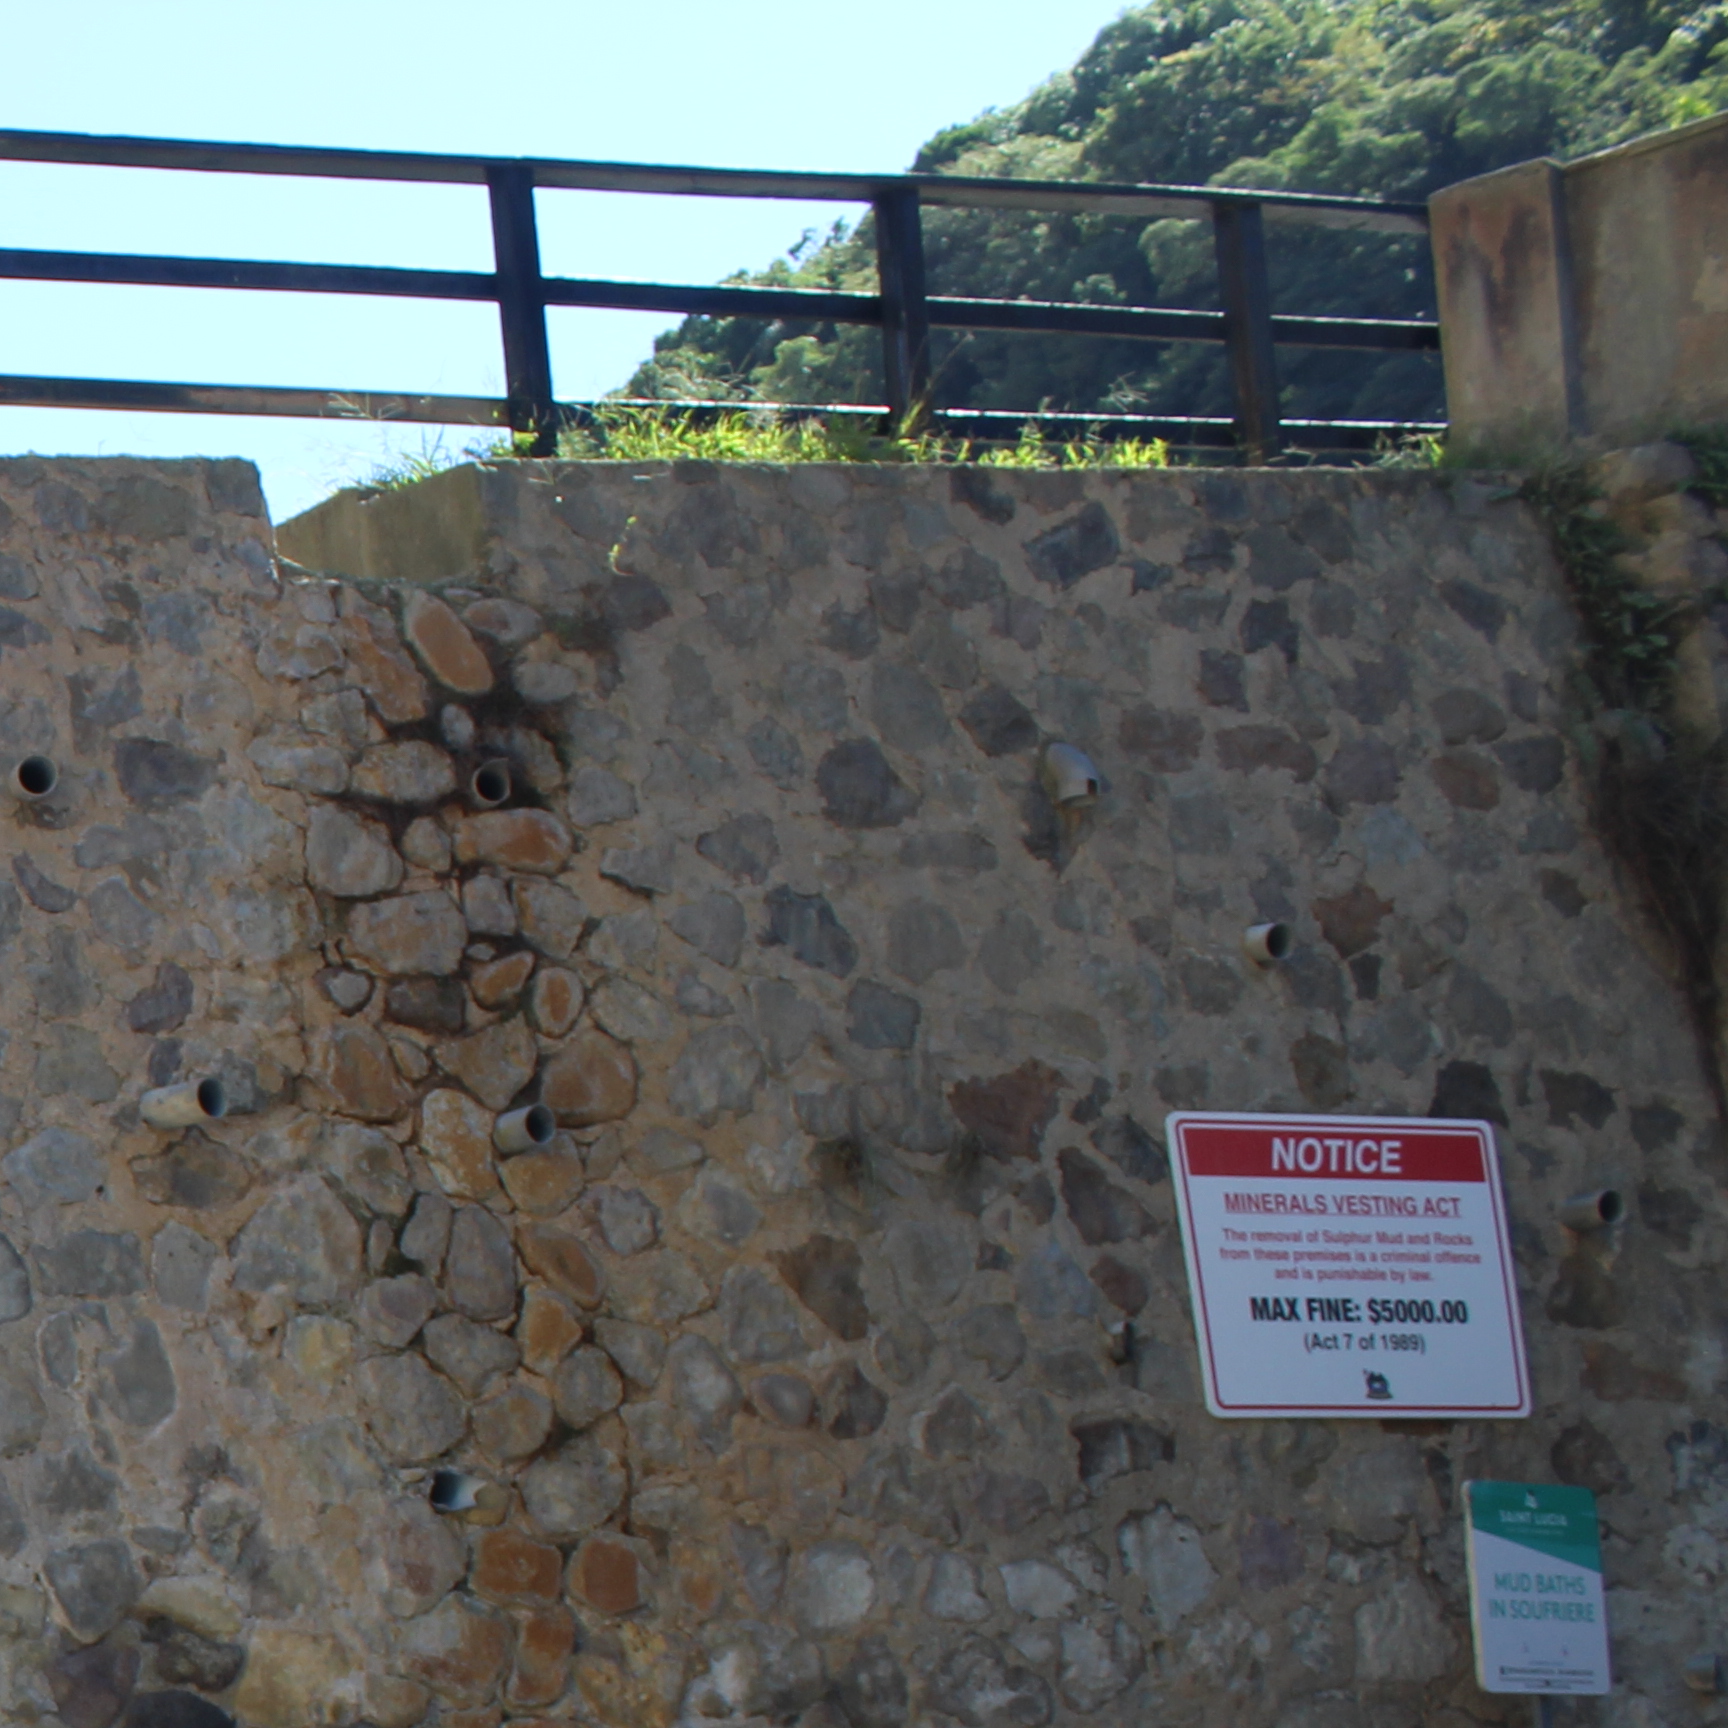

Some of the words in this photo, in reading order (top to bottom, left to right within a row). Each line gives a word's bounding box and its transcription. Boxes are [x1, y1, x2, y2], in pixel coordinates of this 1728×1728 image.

[1272, 1137, 1402, 1174] NOTICE
[1224, 1193, 1327, 1214] MINERALS
[1332, 1195, 1417, 1216] VESTING
[1423, 1197, 1461, 1217] ACT
[1222, 1229, 1247, 1242] The
[1250, 1230, 1301, 1243] removal
[1306, 1230, 1319, 1243] of
[1322, 1231, 1372, 1247] Sulphur
[1376, 1231, 1403, 1244] Mud
[1407, 1232, 1430, 1245] and
[1433, 1233, 1473, 1246] Rocks
[1220, 1248, 1250, 1261] from
[1254, 1248, 1289, 1261] these
[1293, 1249, 1350, 1265] premises
[1354, 1250, 1366, 1262] is
[1369, 1253, 1377, 1262] a
[1381, 1250, 1431, 1263] criminal
[1435, 1251, 1481, 1264] offence
[1274, 1267, 1298, 1280] and
[1302, 1268, 1314, 1280] is
[1317, 1268, 1387, 1284] punishable
[1390, 1269, 1405, 1285] by
[1250, 1297, 1299, 1322] MAX
[1306, 1298, 1362, 1322] FINE:
[1368, 1297, 1468, 1325] $5000.00
[1304, 1333, 1339, 1353] (Act
[1343, 1334, 1353, 1350] 7
[1358, 1334, 1376, 1351] of
[1381, 1334, 1426, 1354] 1989)
[1494, 1573, 1531, 1591] MUD
[1536, 1574, 1586, 1595] BATHS
[1489, 1600, 1506, 1618] IN
[1511, 1601, 1595, 1622] SOUFRIERE
